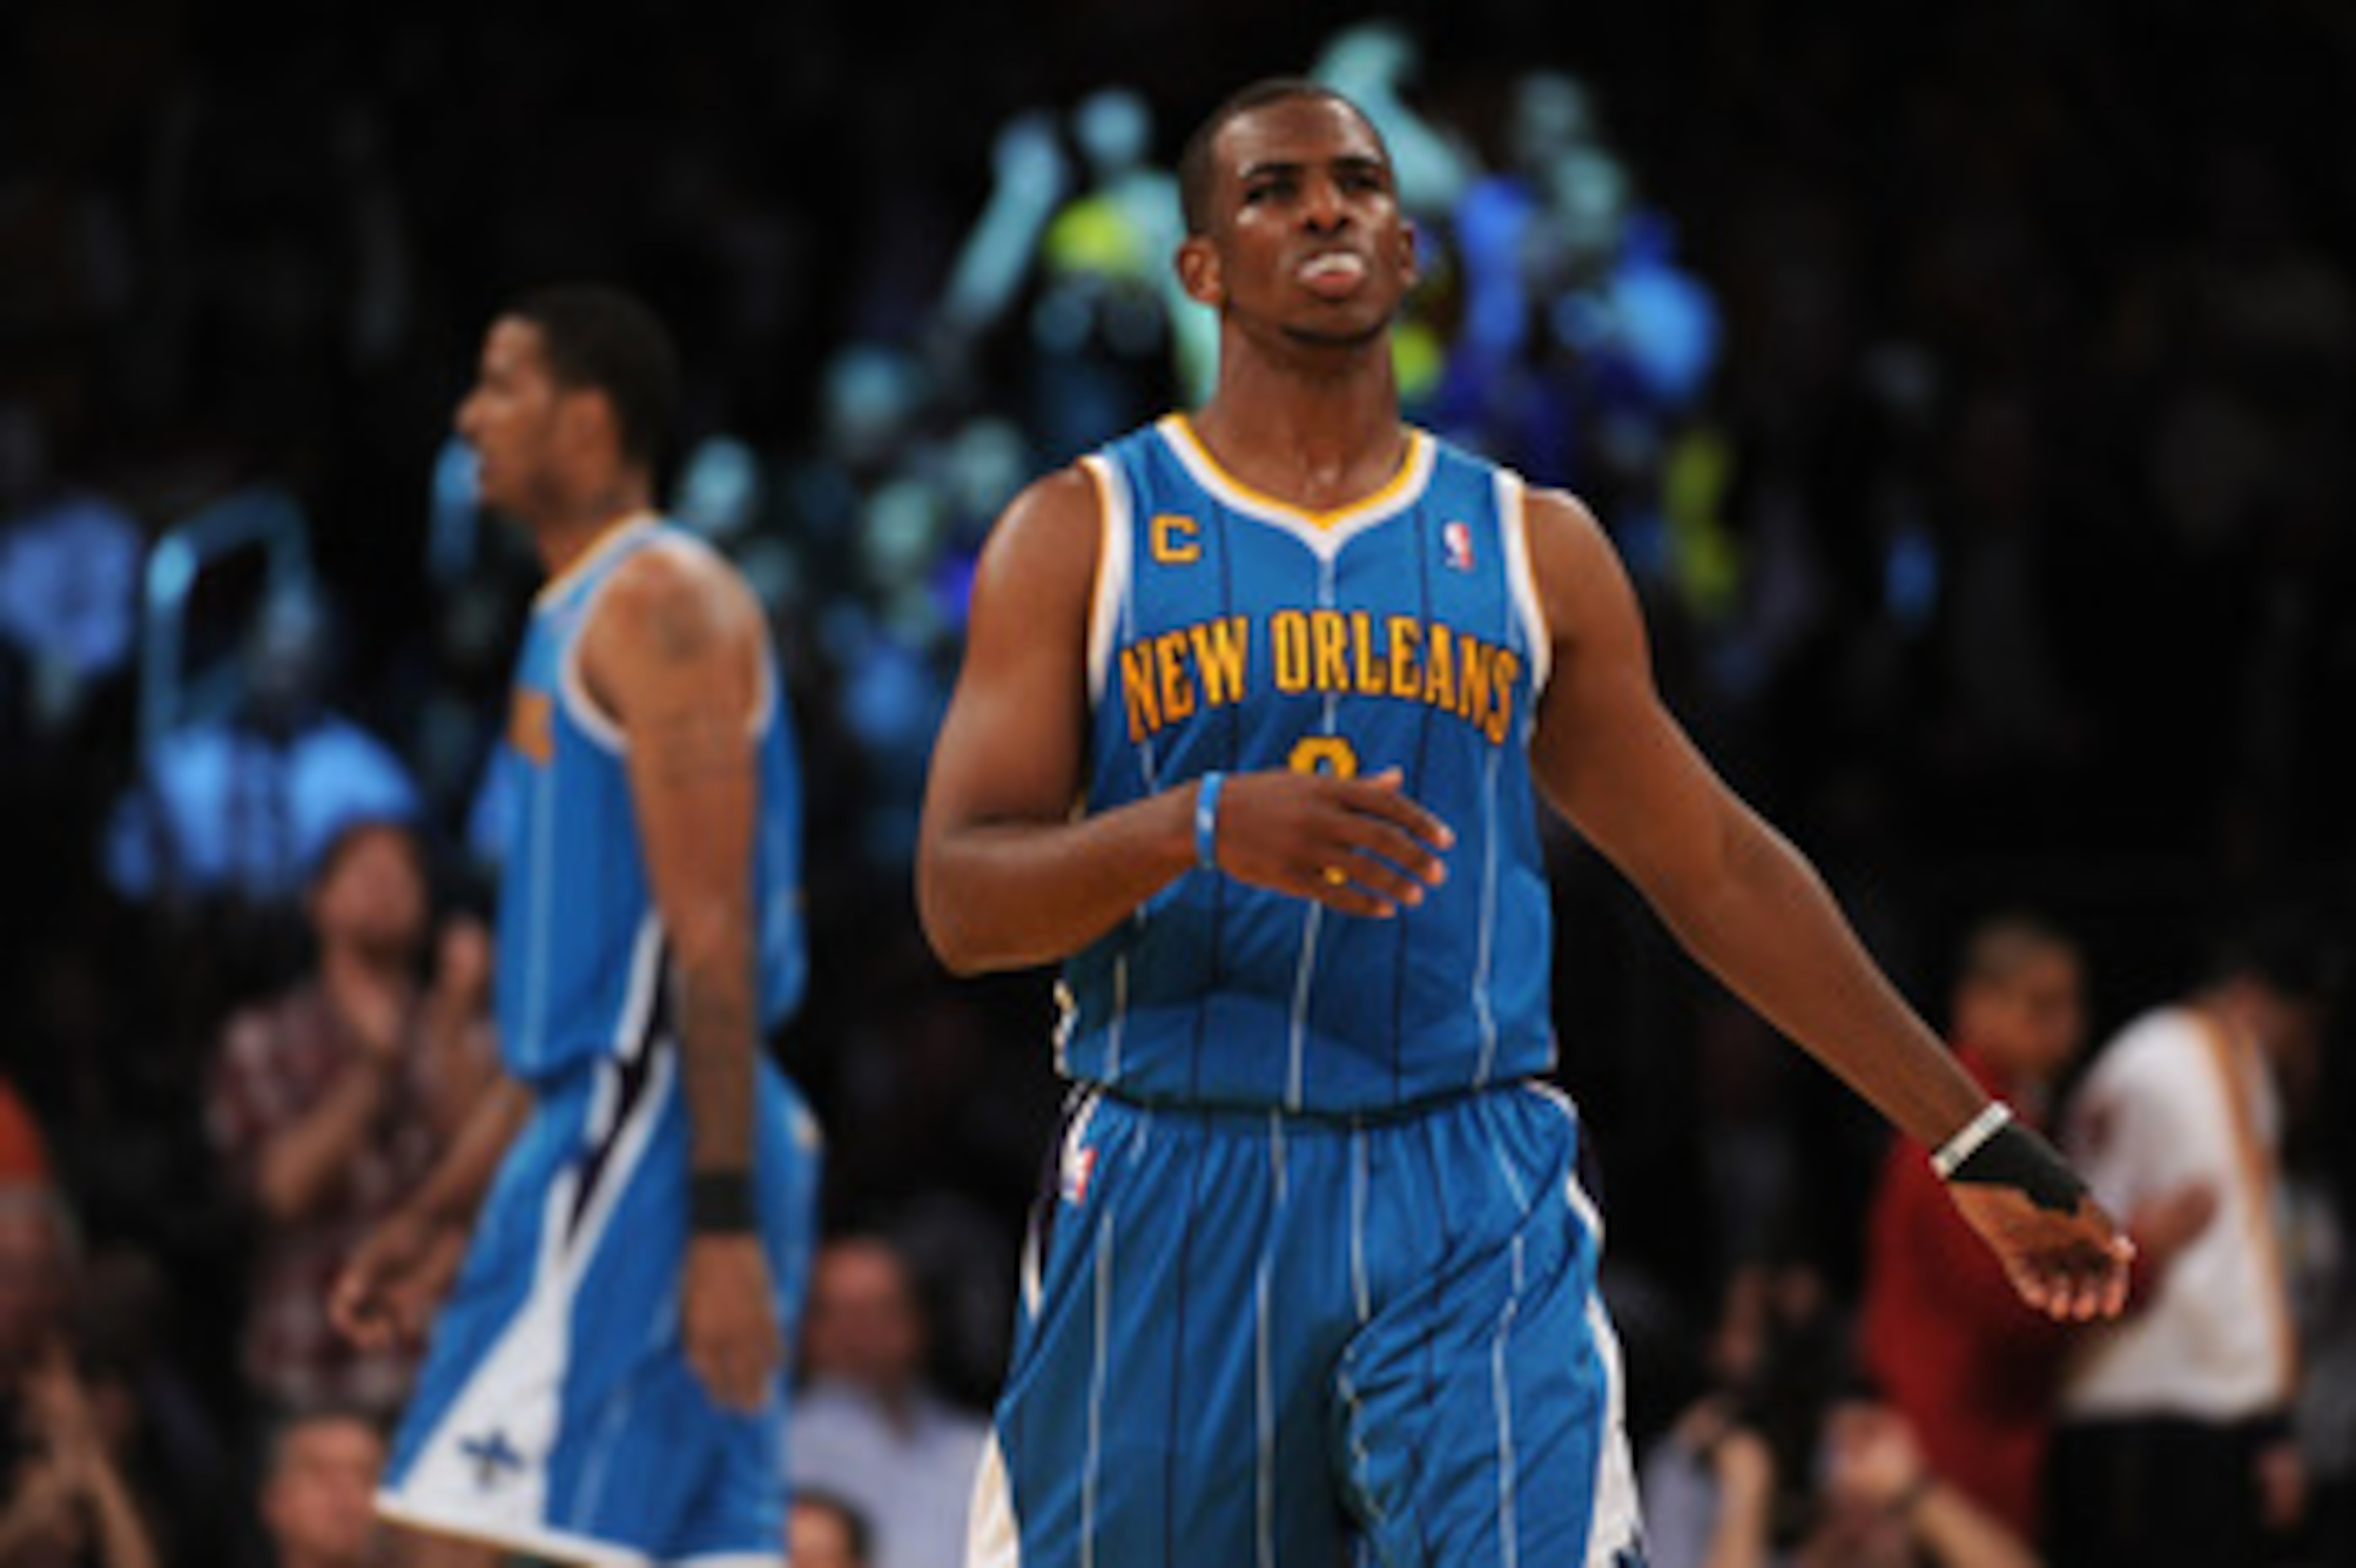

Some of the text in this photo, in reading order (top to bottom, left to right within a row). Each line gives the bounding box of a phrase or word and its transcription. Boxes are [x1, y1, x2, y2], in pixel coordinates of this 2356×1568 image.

[1150, 514, 1200, 563] C
[1120, 610, 1519, 744] NEW ORLEANS
